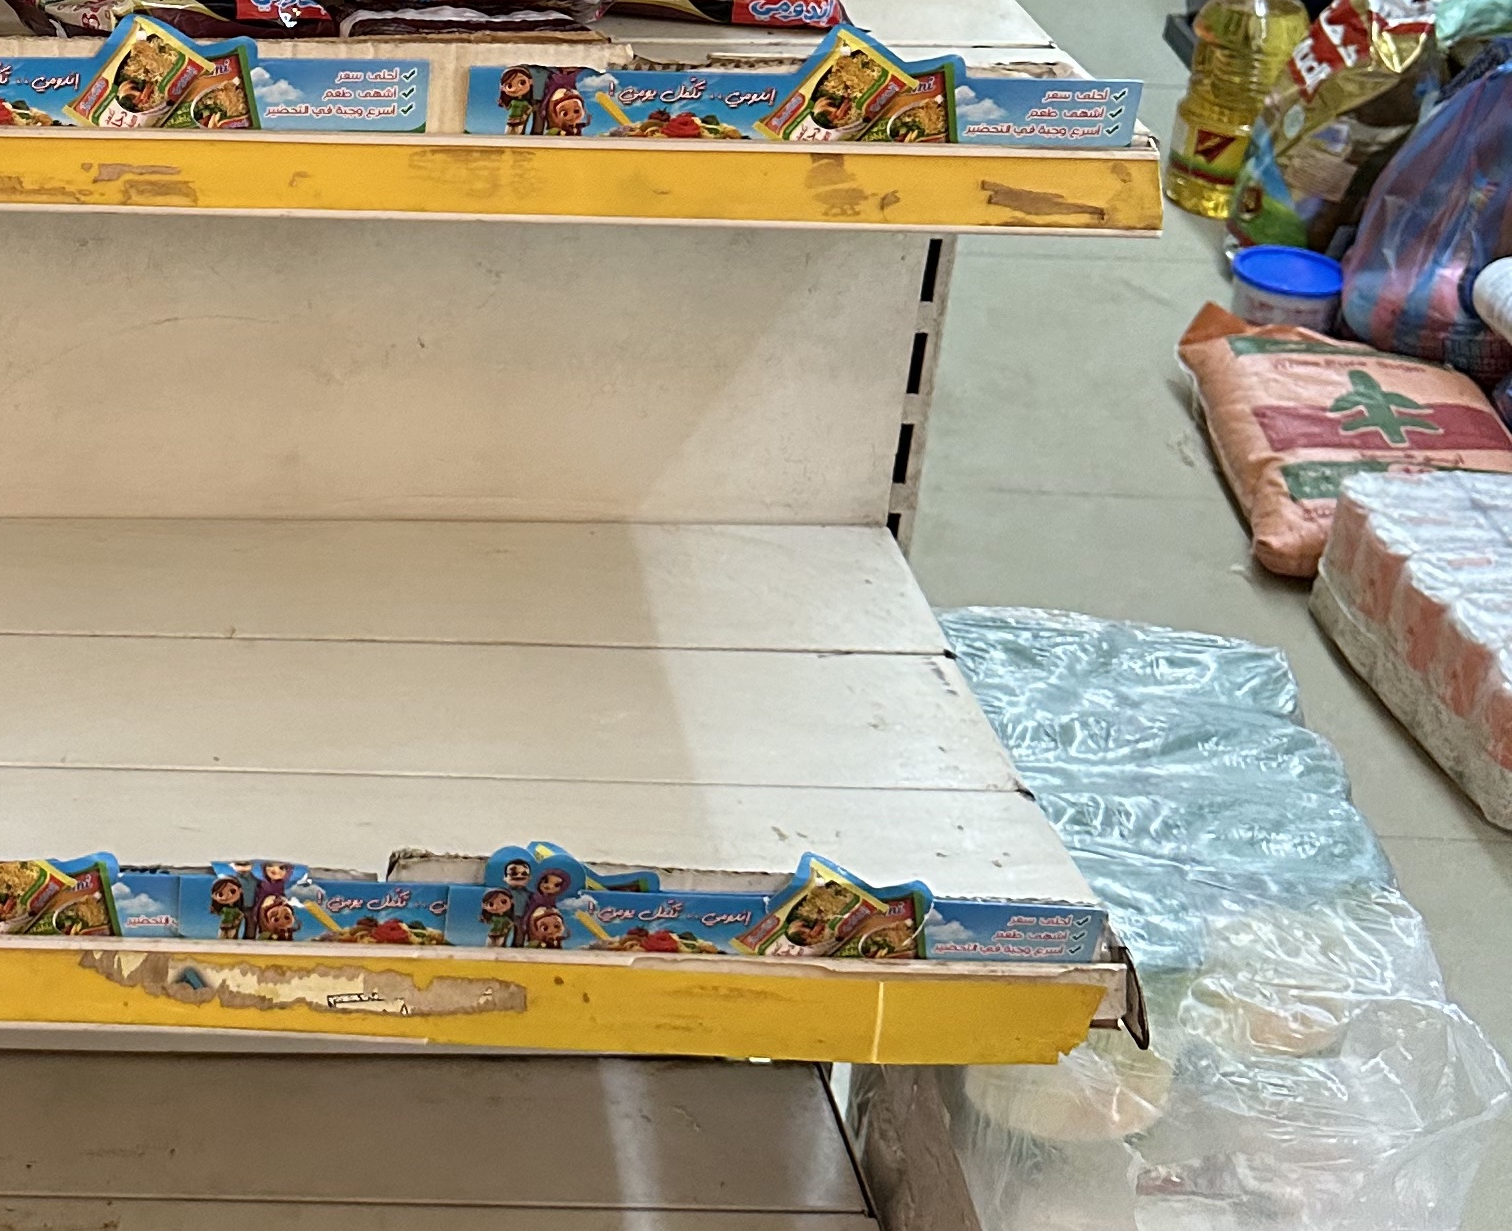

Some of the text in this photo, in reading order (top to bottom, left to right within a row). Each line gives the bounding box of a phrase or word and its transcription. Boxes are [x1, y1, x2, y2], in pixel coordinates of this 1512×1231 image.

[336, 71, 364, 83] سعر
[322, 88, 354, 101] طعم
[1043, 90, 1072, 103] سعر
[265, 104, 310, 117] التحضير
[312, 105, 333, 118] في
[335, 106, 364, 118] وجبة
[1027, 108, 1058, 120] طعم
[965, 123, 1011, 137] التحضير
[1013, 126, 1035, 138] في
[1038, 126, 1067, 138] وجبة
